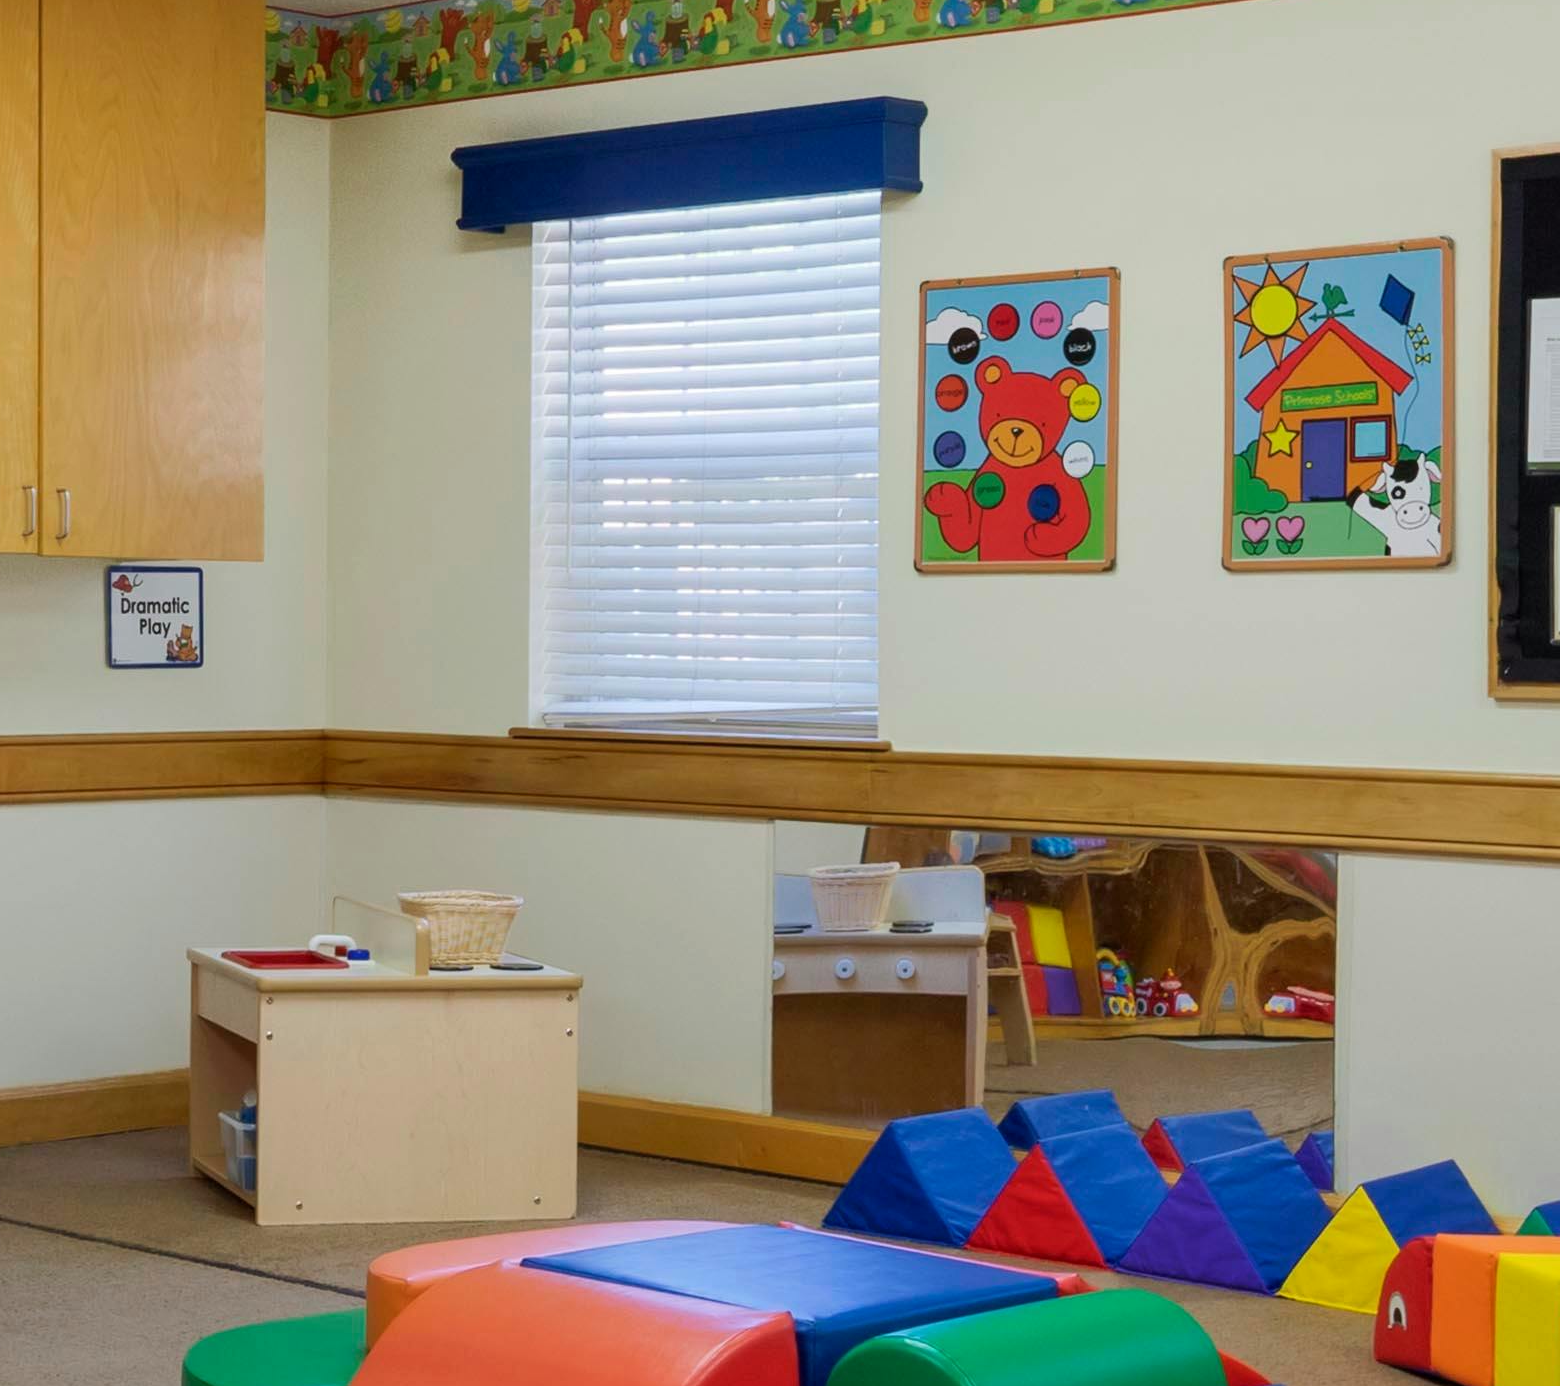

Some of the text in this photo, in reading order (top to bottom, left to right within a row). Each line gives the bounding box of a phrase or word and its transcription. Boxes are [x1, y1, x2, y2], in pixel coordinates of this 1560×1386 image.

[952, 340, 977, 354] brown
[1068, 341, 1092, 354] black
[121, 597, 190, 614] Dramatic
[139, 618, 171, 638] Play
